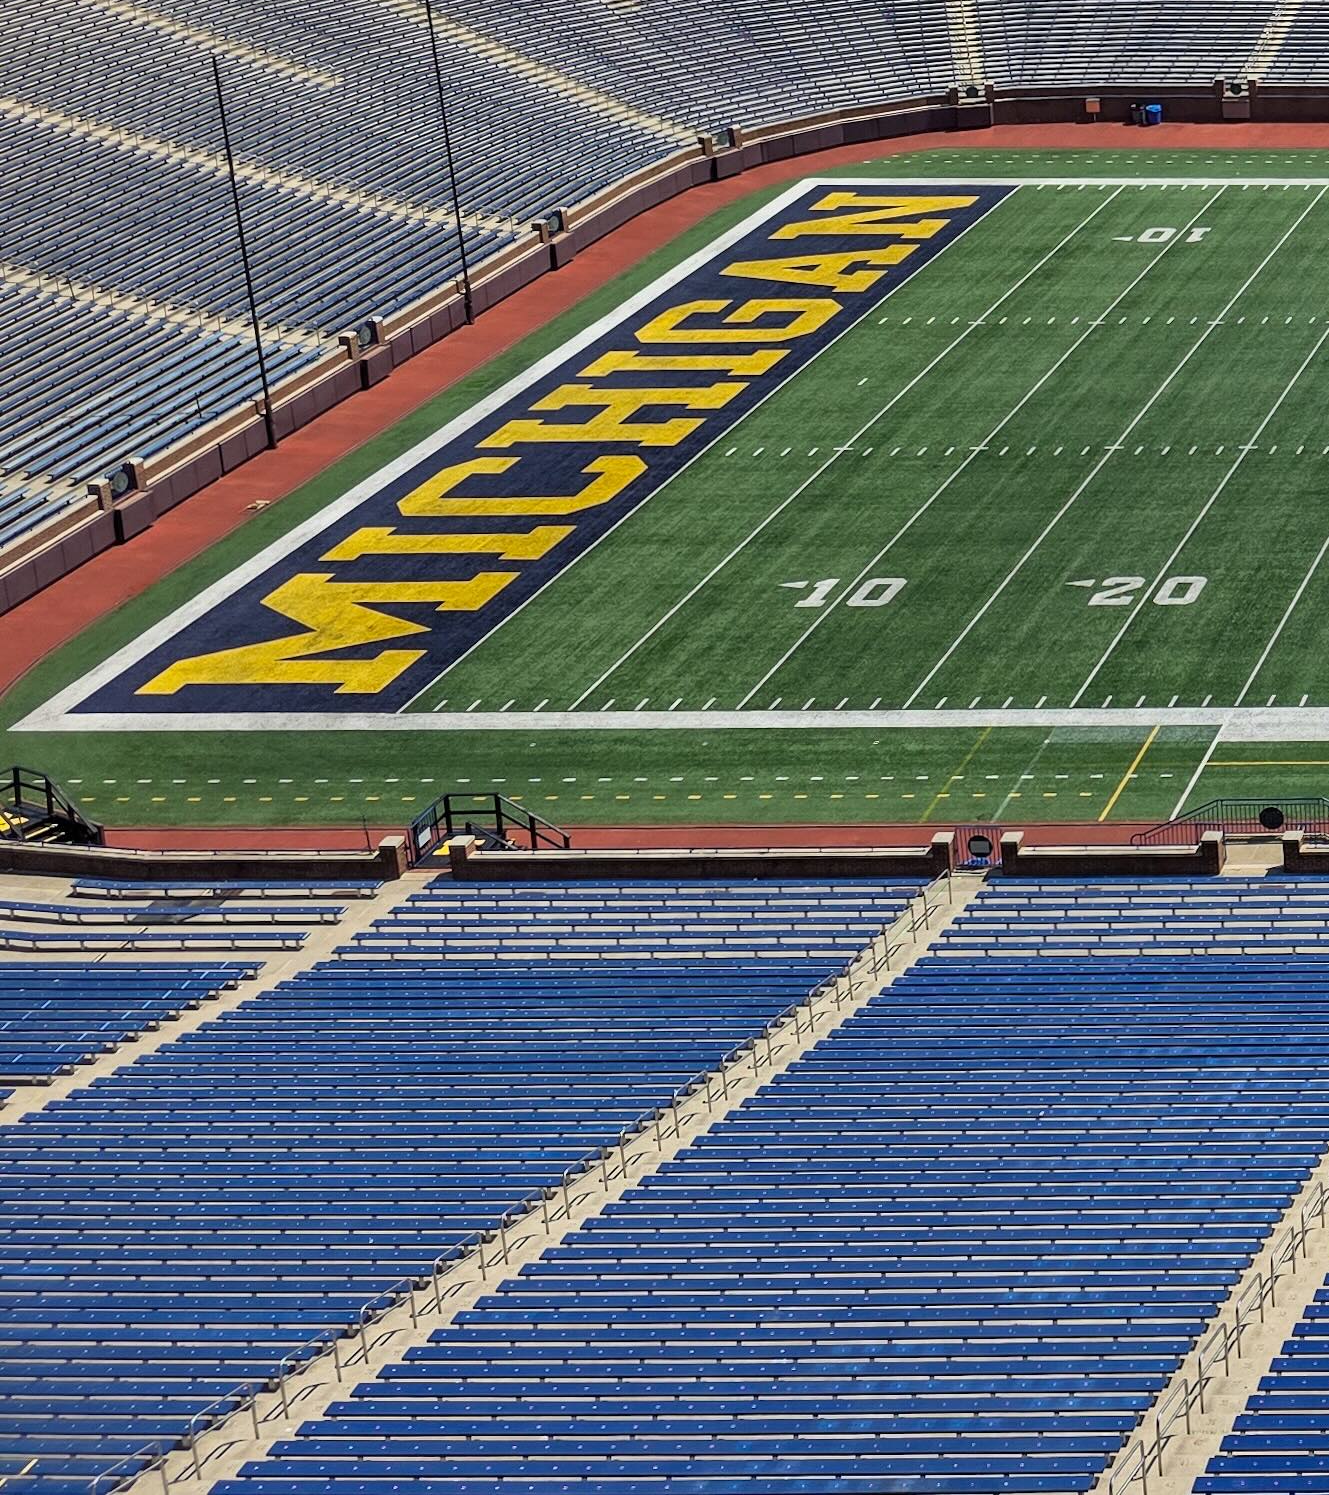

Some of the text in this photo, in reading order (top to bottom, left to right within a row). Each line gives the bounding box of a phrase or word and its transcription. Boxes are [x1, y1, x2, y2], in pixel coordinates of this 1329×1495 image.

[1137, 226, 1212, 244] 10
[134, 191, 981, 696] MICHIGAN
[794, 577, 908, 608] 10
[1087, 575, 1208, 606] 20
